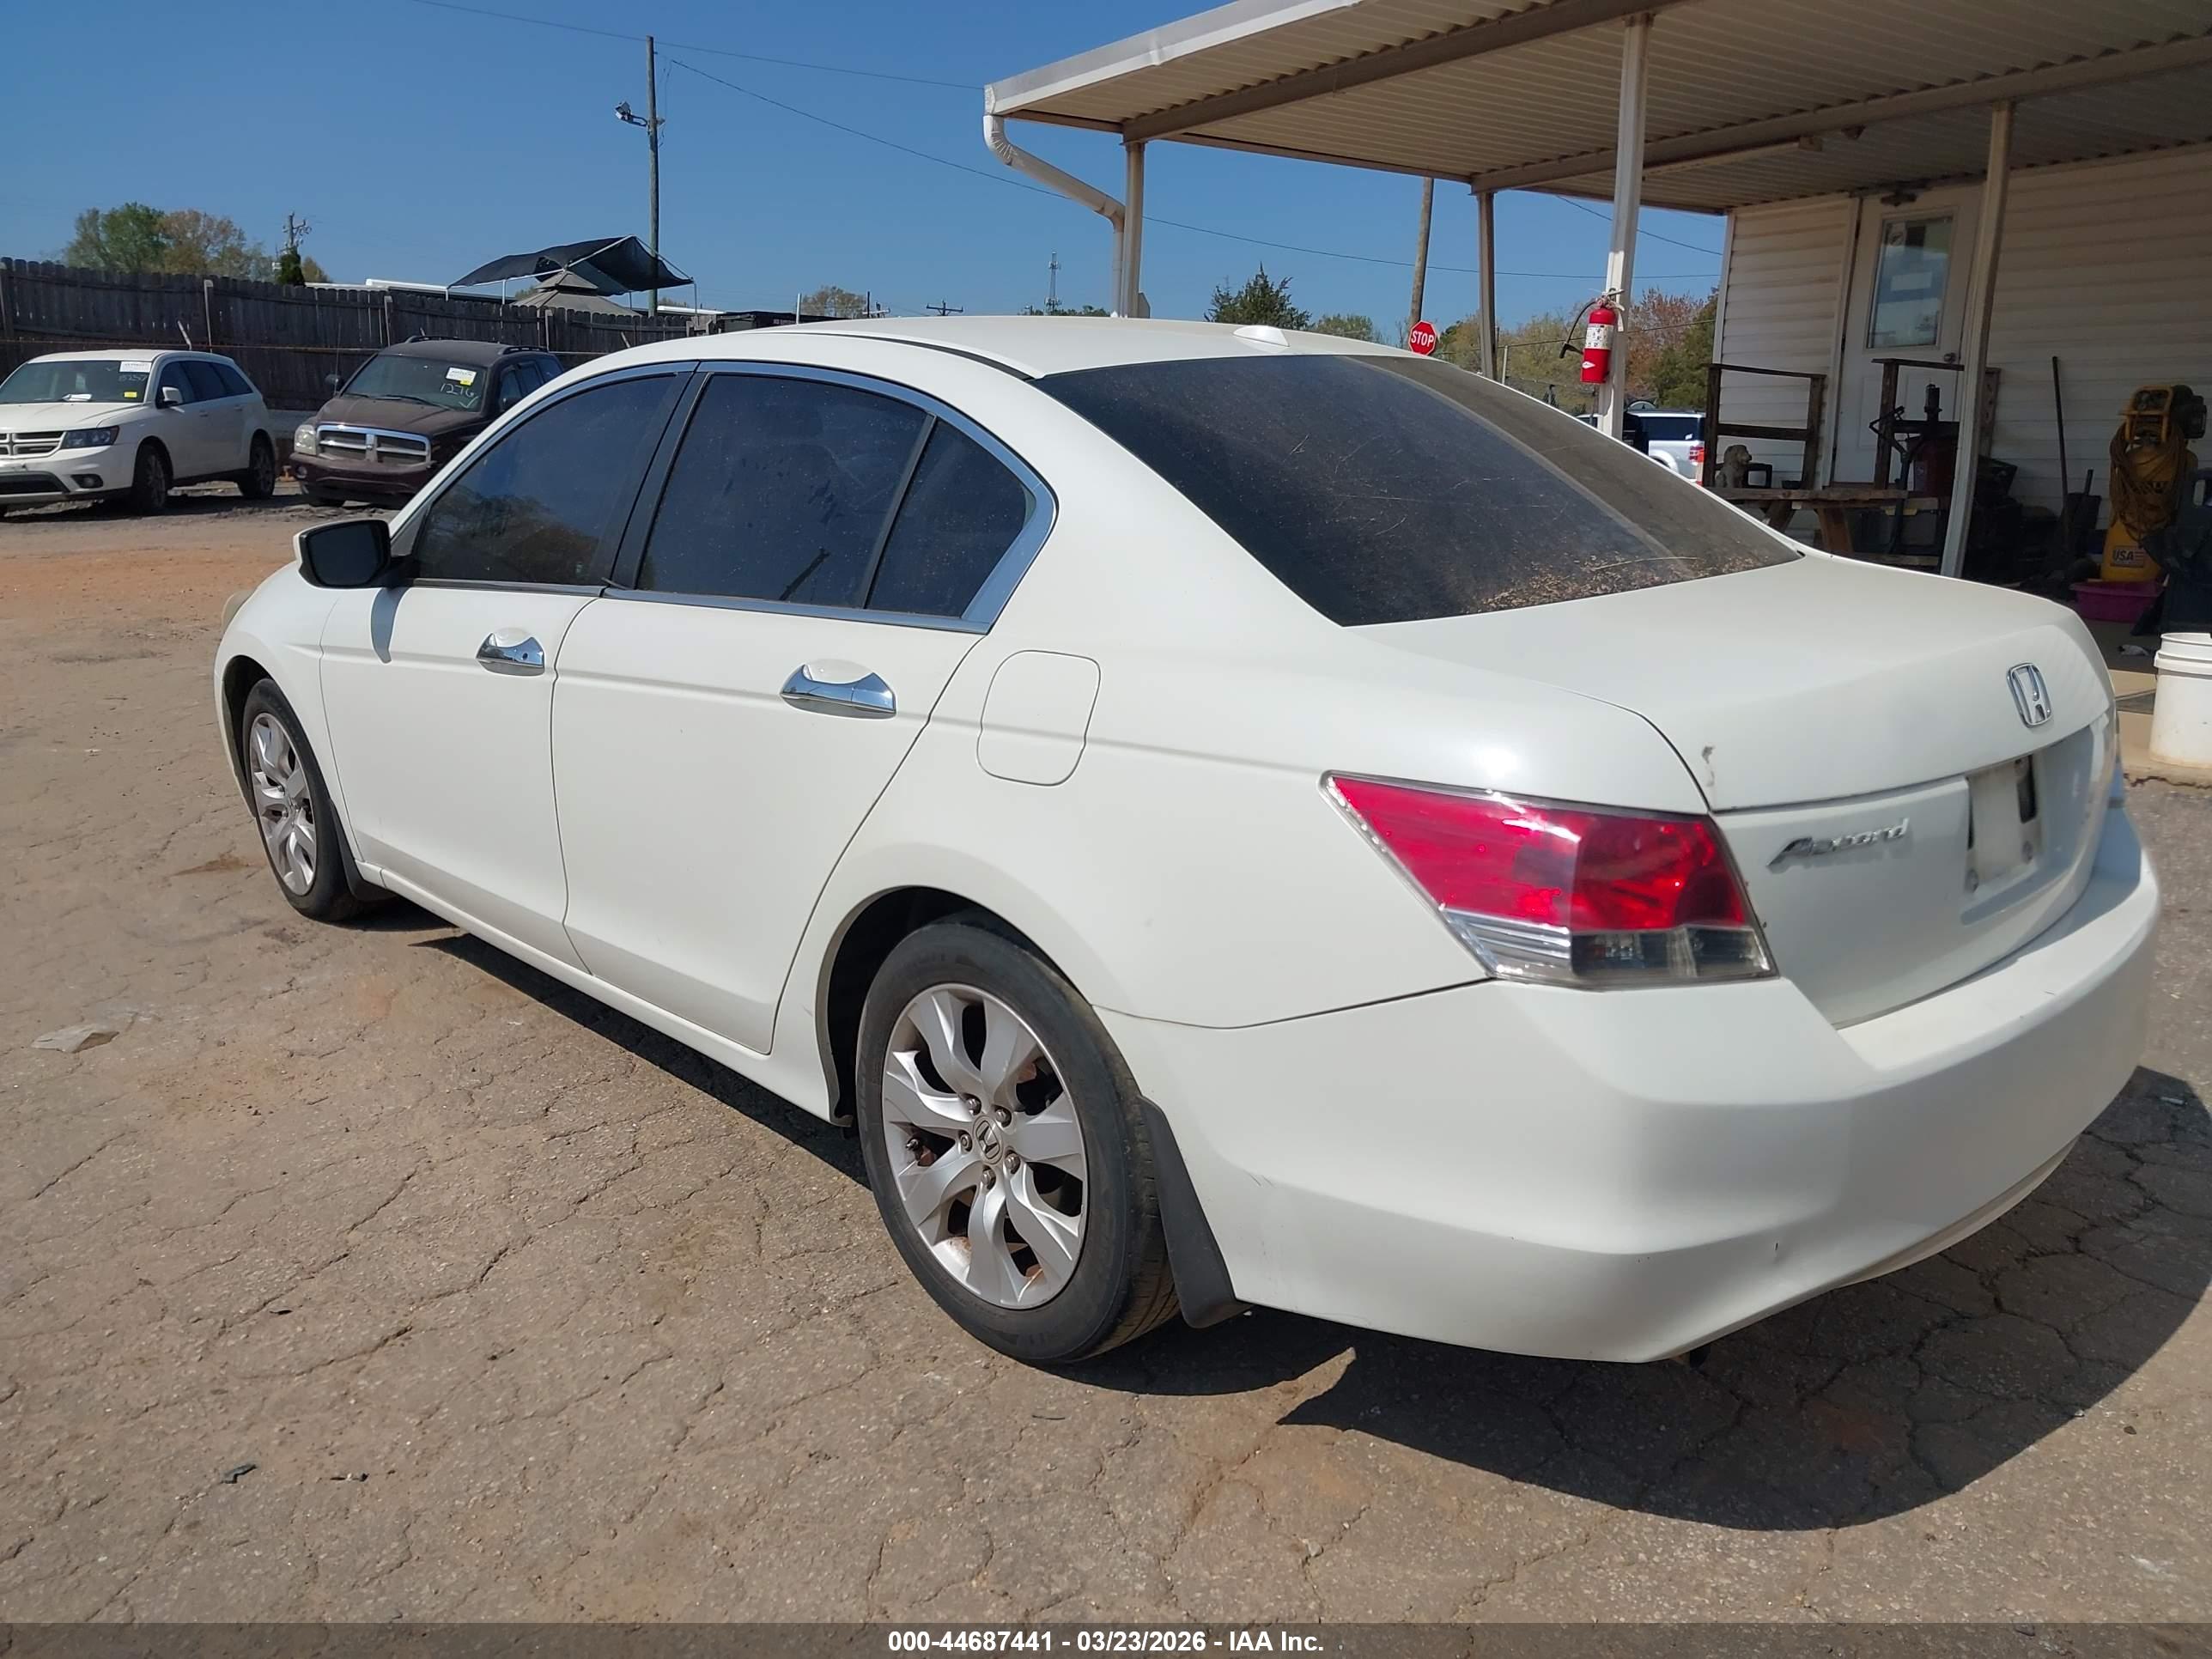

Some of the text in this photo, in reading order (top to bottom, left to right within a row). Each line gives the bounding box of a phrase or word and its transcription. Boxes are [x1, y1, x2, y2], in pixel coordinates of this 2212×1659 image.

[1411, 330, 1434, 347] STOP
[2113, 550, 2134, 561] USA
[1765, 817, 1910, 866] Accord
